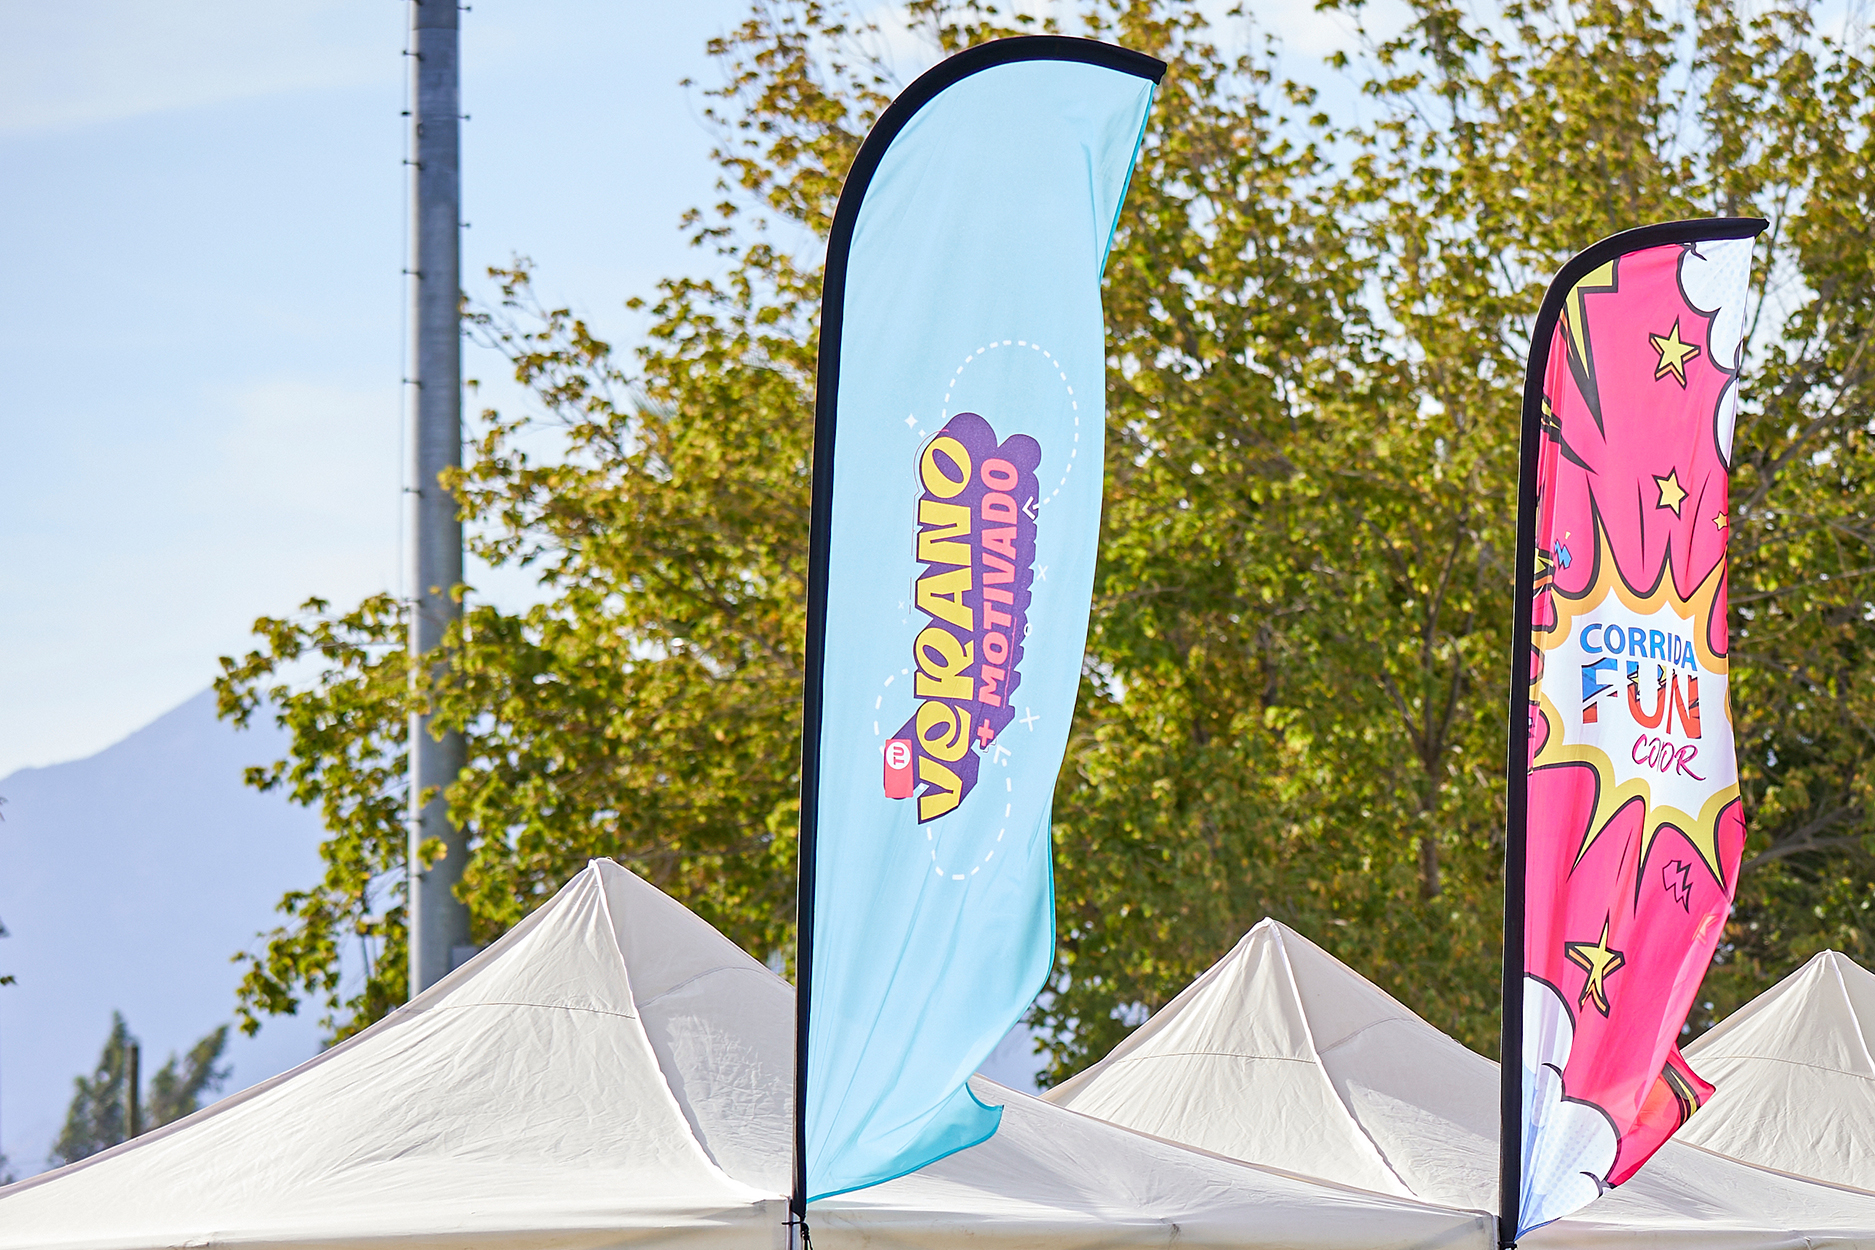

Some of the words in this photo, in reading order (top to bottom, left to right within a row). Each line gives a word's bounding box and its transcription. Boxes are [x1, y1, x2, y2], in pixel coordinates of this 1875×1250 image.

[980, 458, 1019, 707] MOTIVADO
[1579, 623, 1698, 671] CORRIDA
[1581, 657, 1702, 739] FUN
[893, 746, 904, 766] TU
